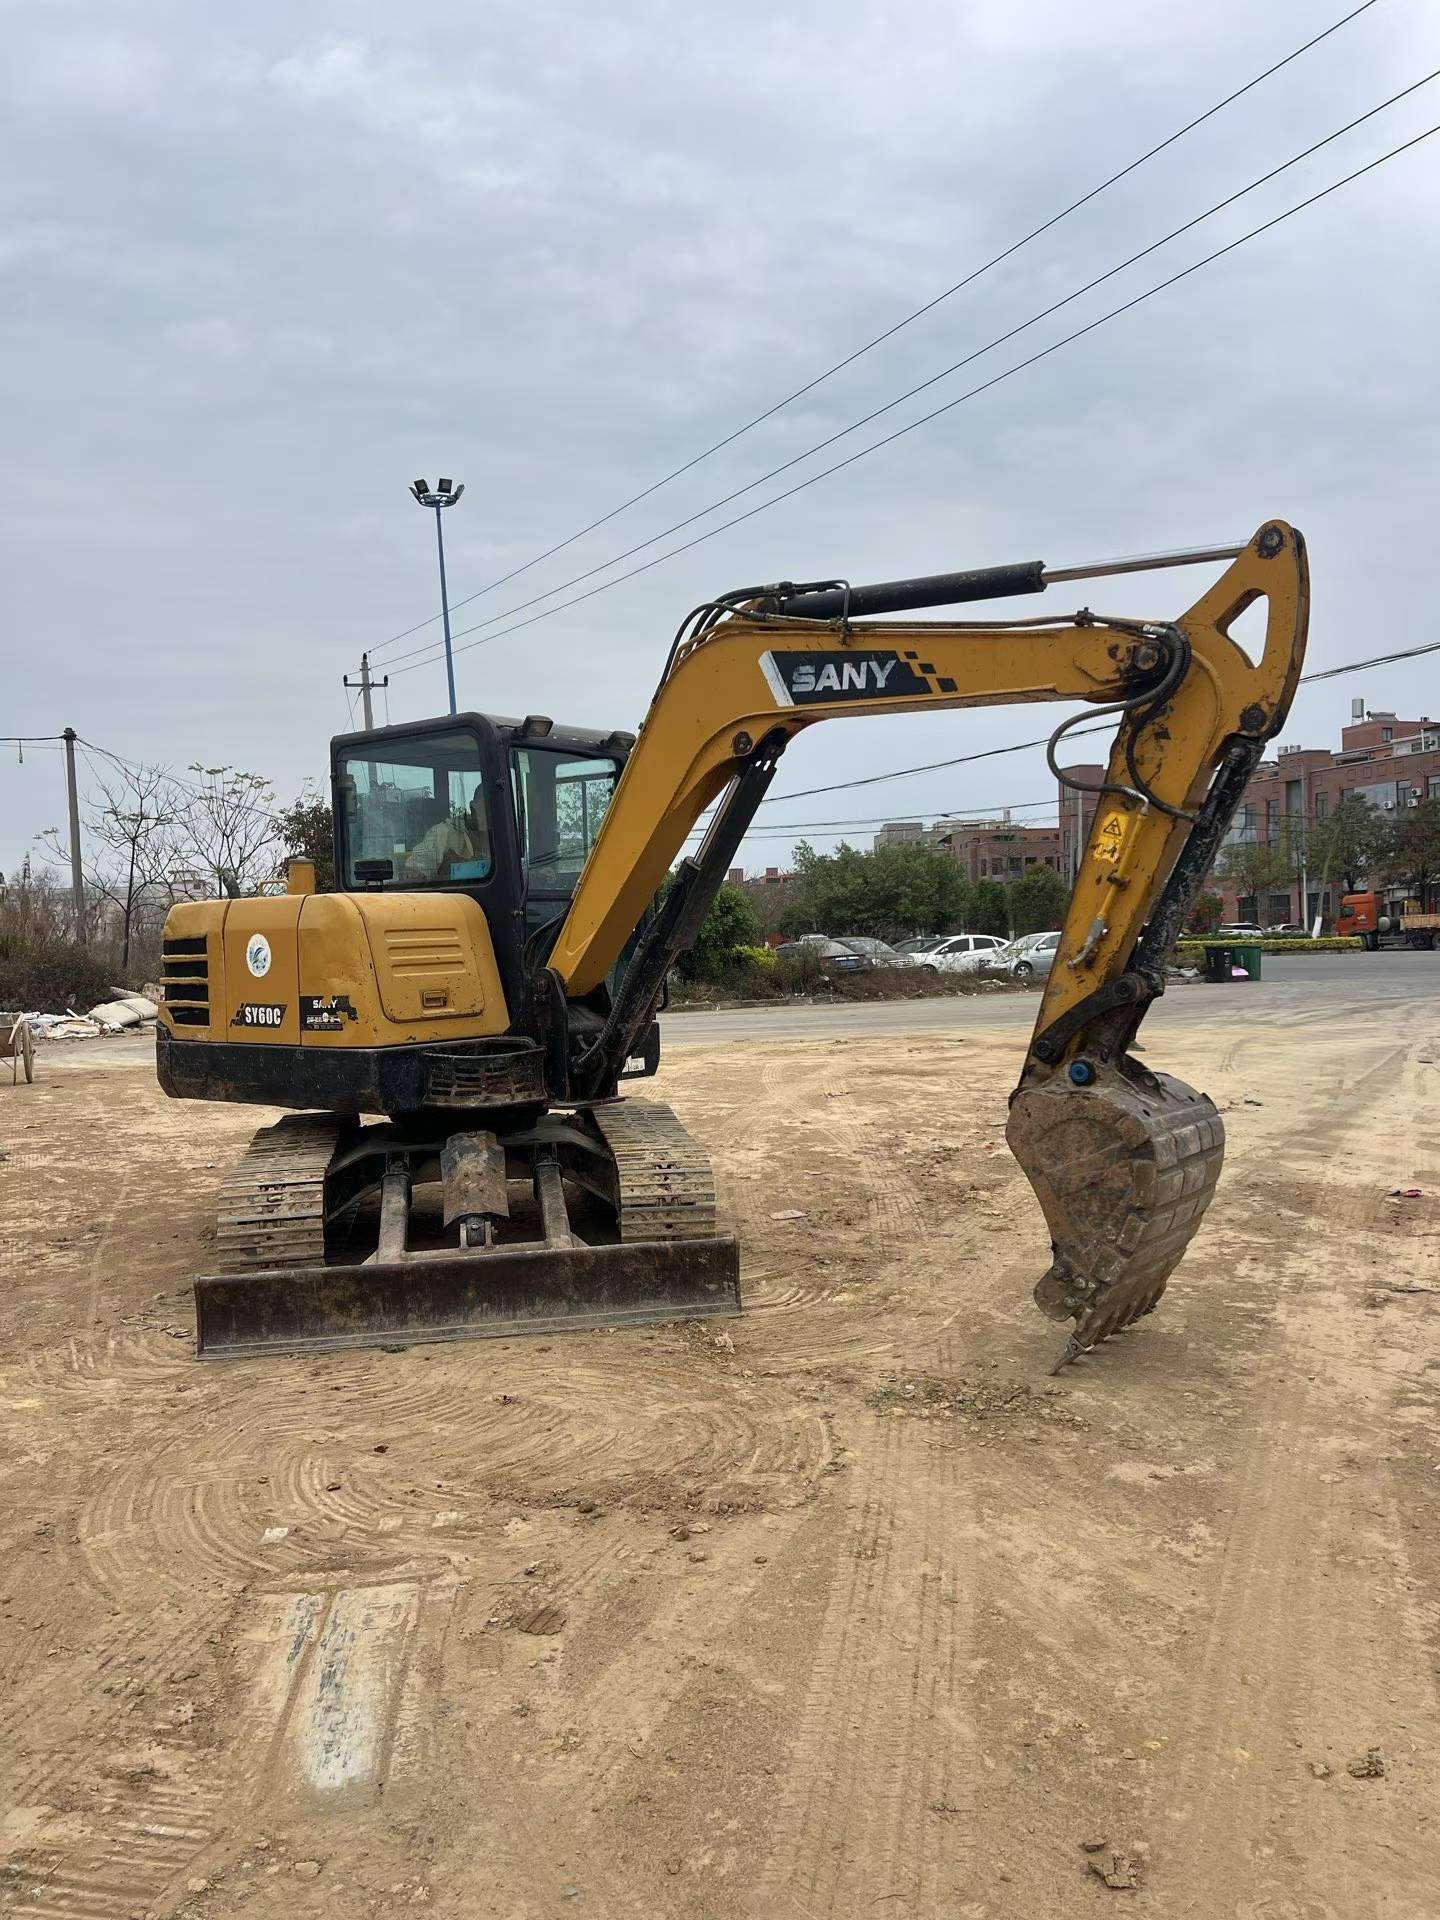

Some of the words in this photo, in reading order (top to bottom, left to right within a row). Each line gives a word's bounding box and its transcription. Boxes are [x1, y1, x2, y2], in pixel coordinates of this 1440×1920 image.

[792, 659, 897, 693] SANY
[312, 999, 338, 1009] SY
[245, 1006, 281, 1025] SY60C
